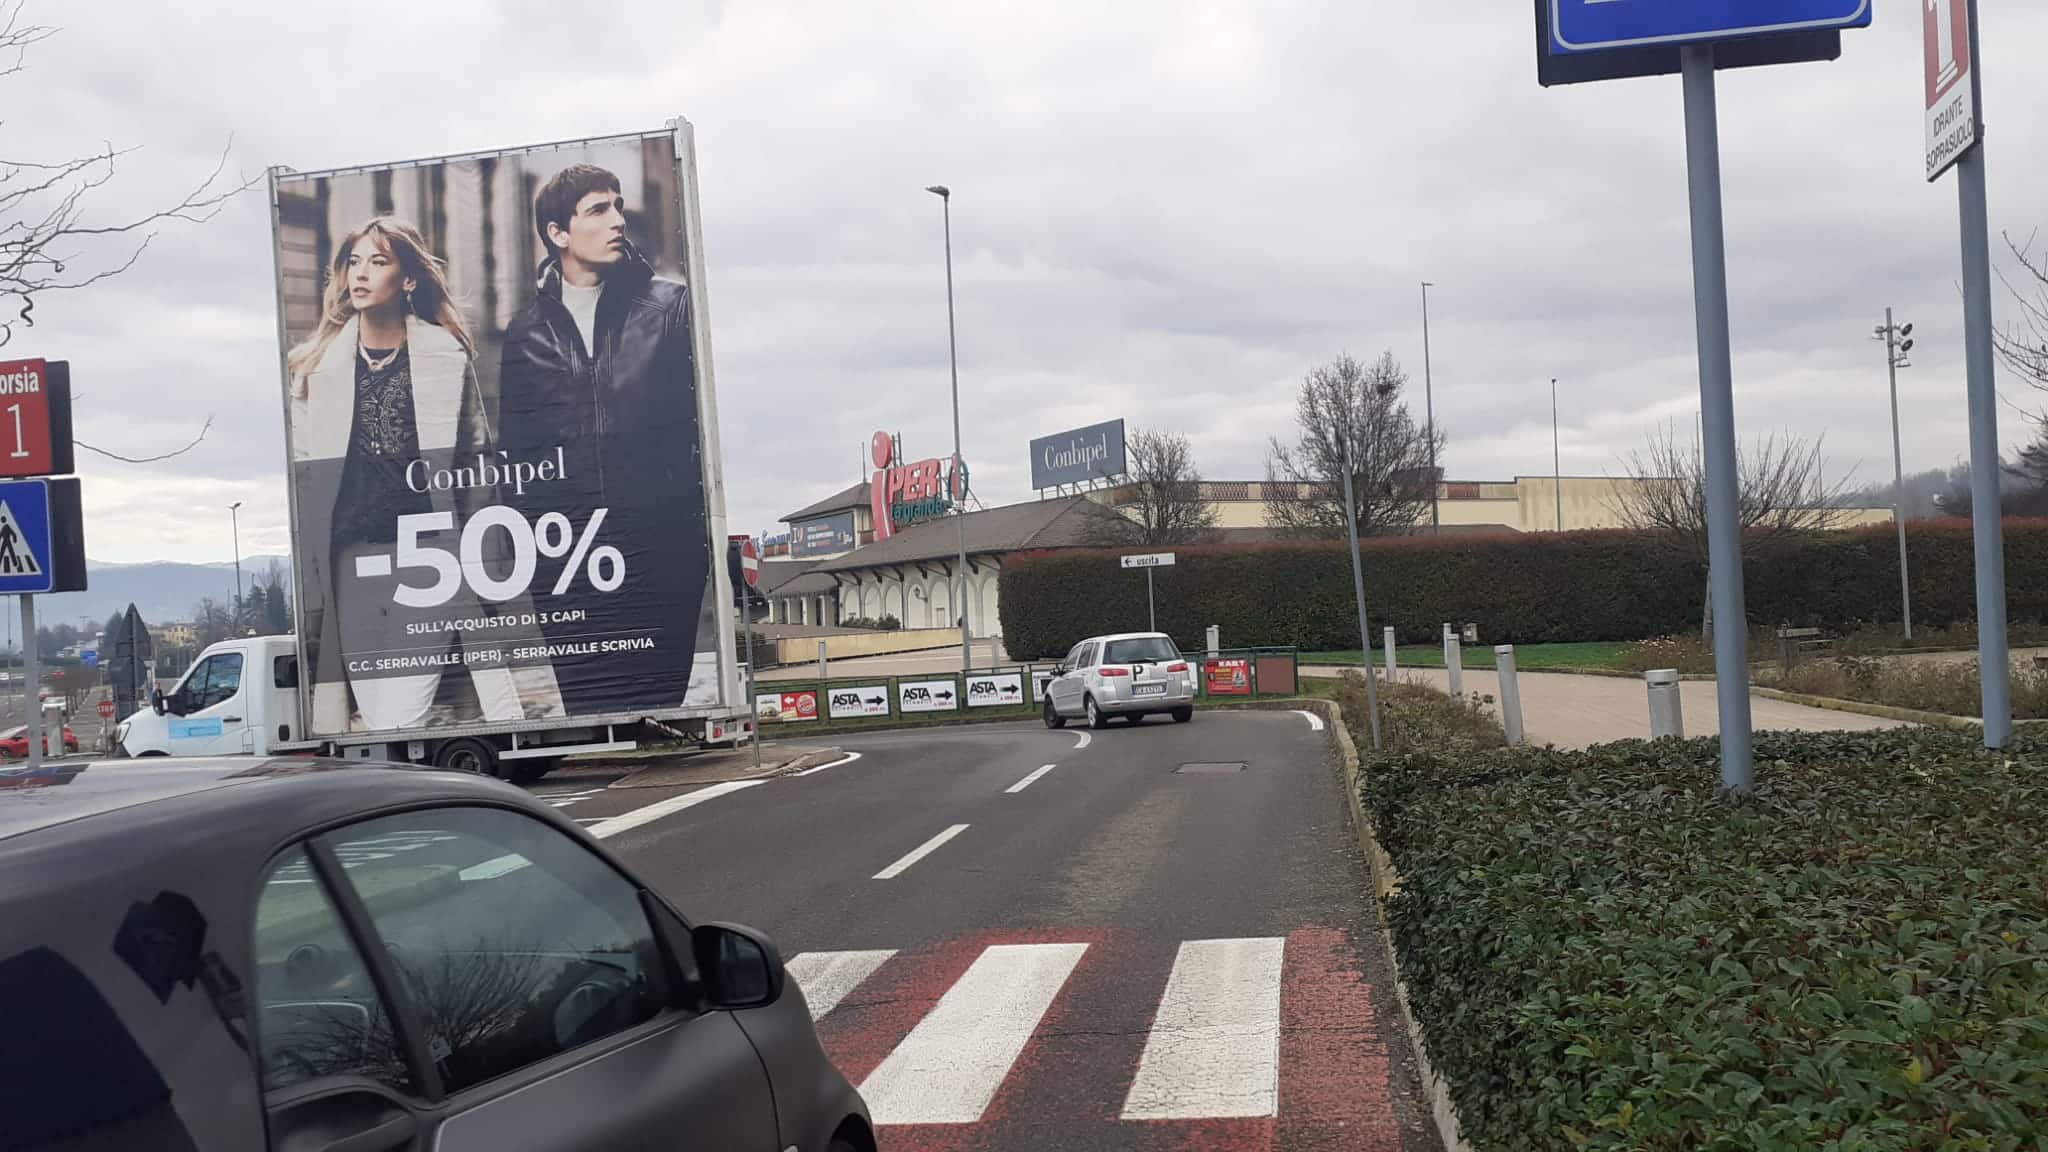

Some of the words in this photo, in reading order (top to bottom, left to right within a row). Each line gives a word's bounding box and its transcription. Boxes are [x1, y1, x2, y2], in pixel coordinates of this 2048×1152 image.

[1933, 94, 1963, 137] IDRANTE
[1926, 117, 1974, 171] SOPRASUOLO
[7, 403, 30, 457] 1
[405, 446, 568, 495] Conbipel
[1044, 432, 1109, 472] Conbipel
[355, 505, 626, 608] -50%
[406, 616, 517, 635] SULL'ACQUISTO
[521, 614, 537, 625] DI
[540, 613, 549, 625] 3
[552, 610, 586, 623] CAPI
[349, 661, 374, 673] C.C.
[375, 653, 460, 671] SERRAVALLE
[463, 649, 502, 666] (IPER)
[513, 641, 598, 660] SERRAVALLE
[601, 637, 655, 652] SCRIVIA
[1132, 664, 1144, 681] P
[832, 693, 862, 706] ASTA
[903, 687, 931, 700] ASTA
[968, 681, 999, 694] ASTA
